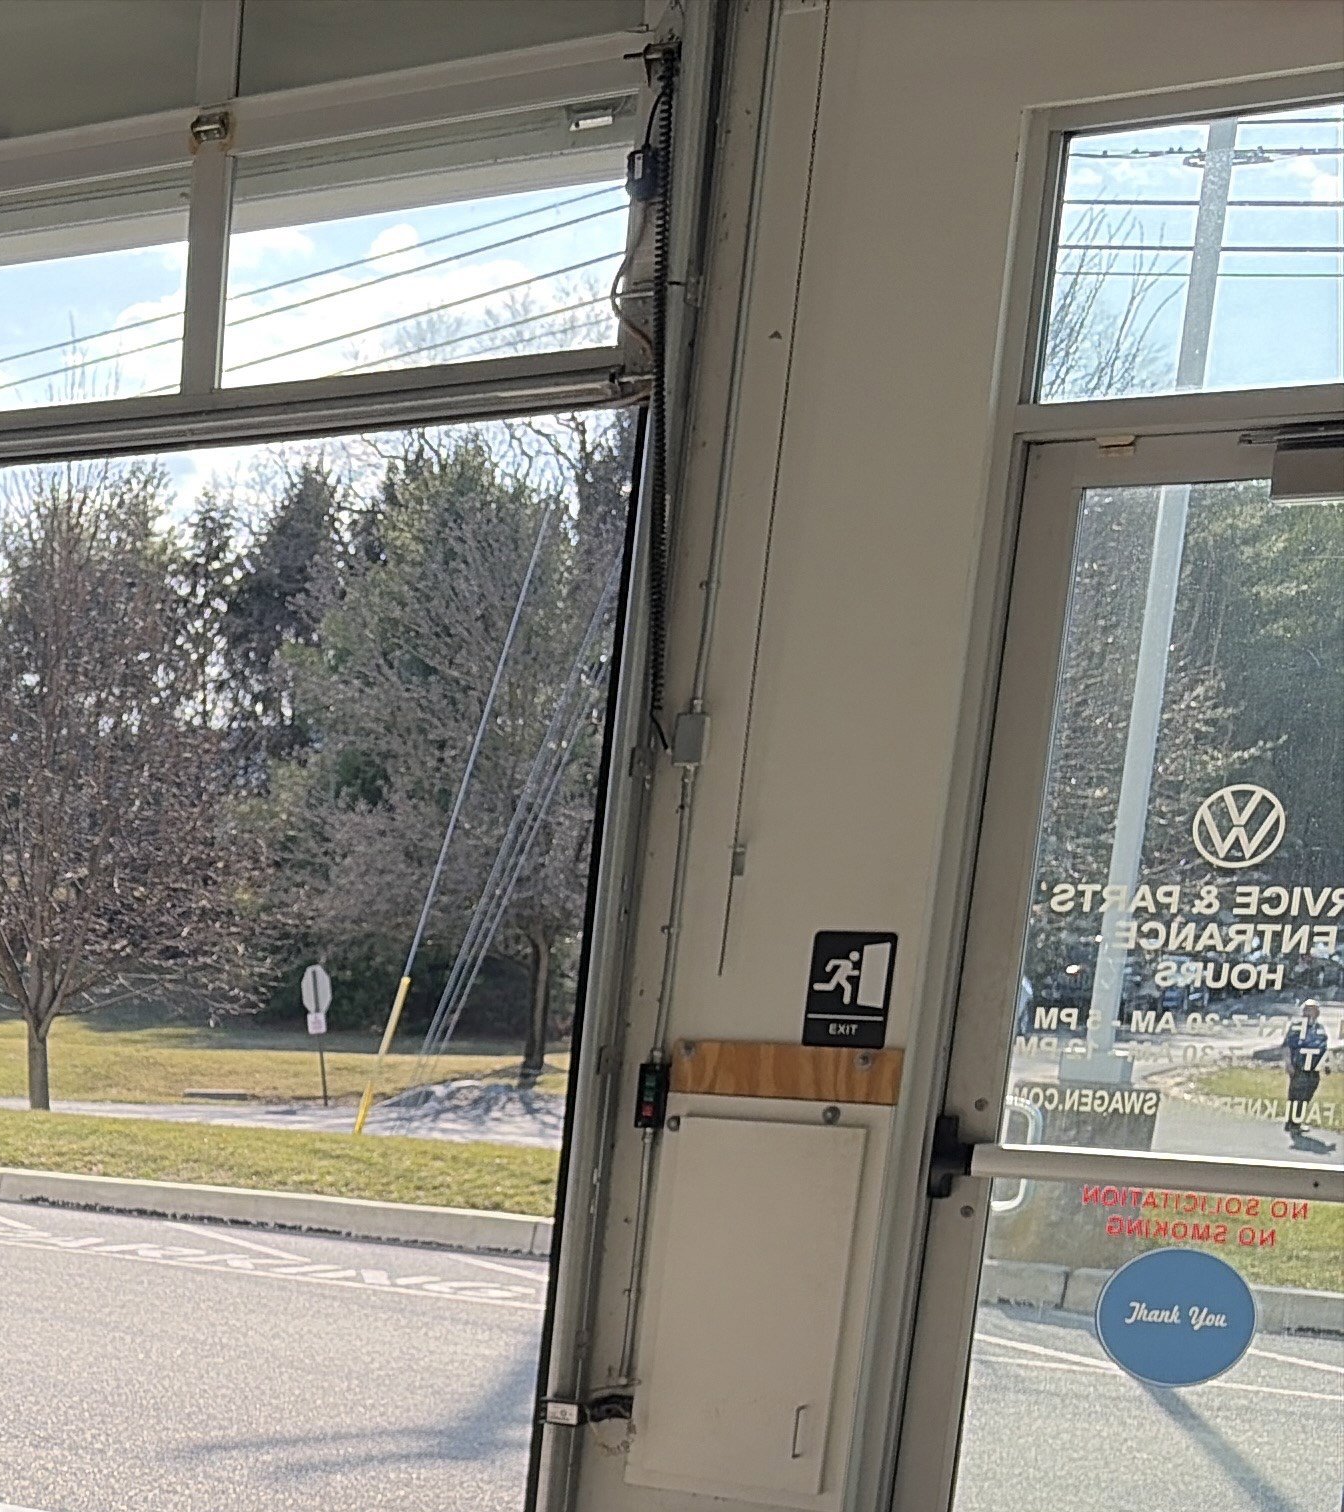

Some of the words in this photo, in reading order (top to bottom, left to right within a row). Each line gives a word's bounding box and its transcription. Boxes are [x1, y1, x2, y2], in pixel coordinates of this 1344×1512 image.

[829, 1022, 859, 1036] EXIT
[1125, 1301, 1181, 1324] Thank
[1189, 1305, 1228, 1331] You
